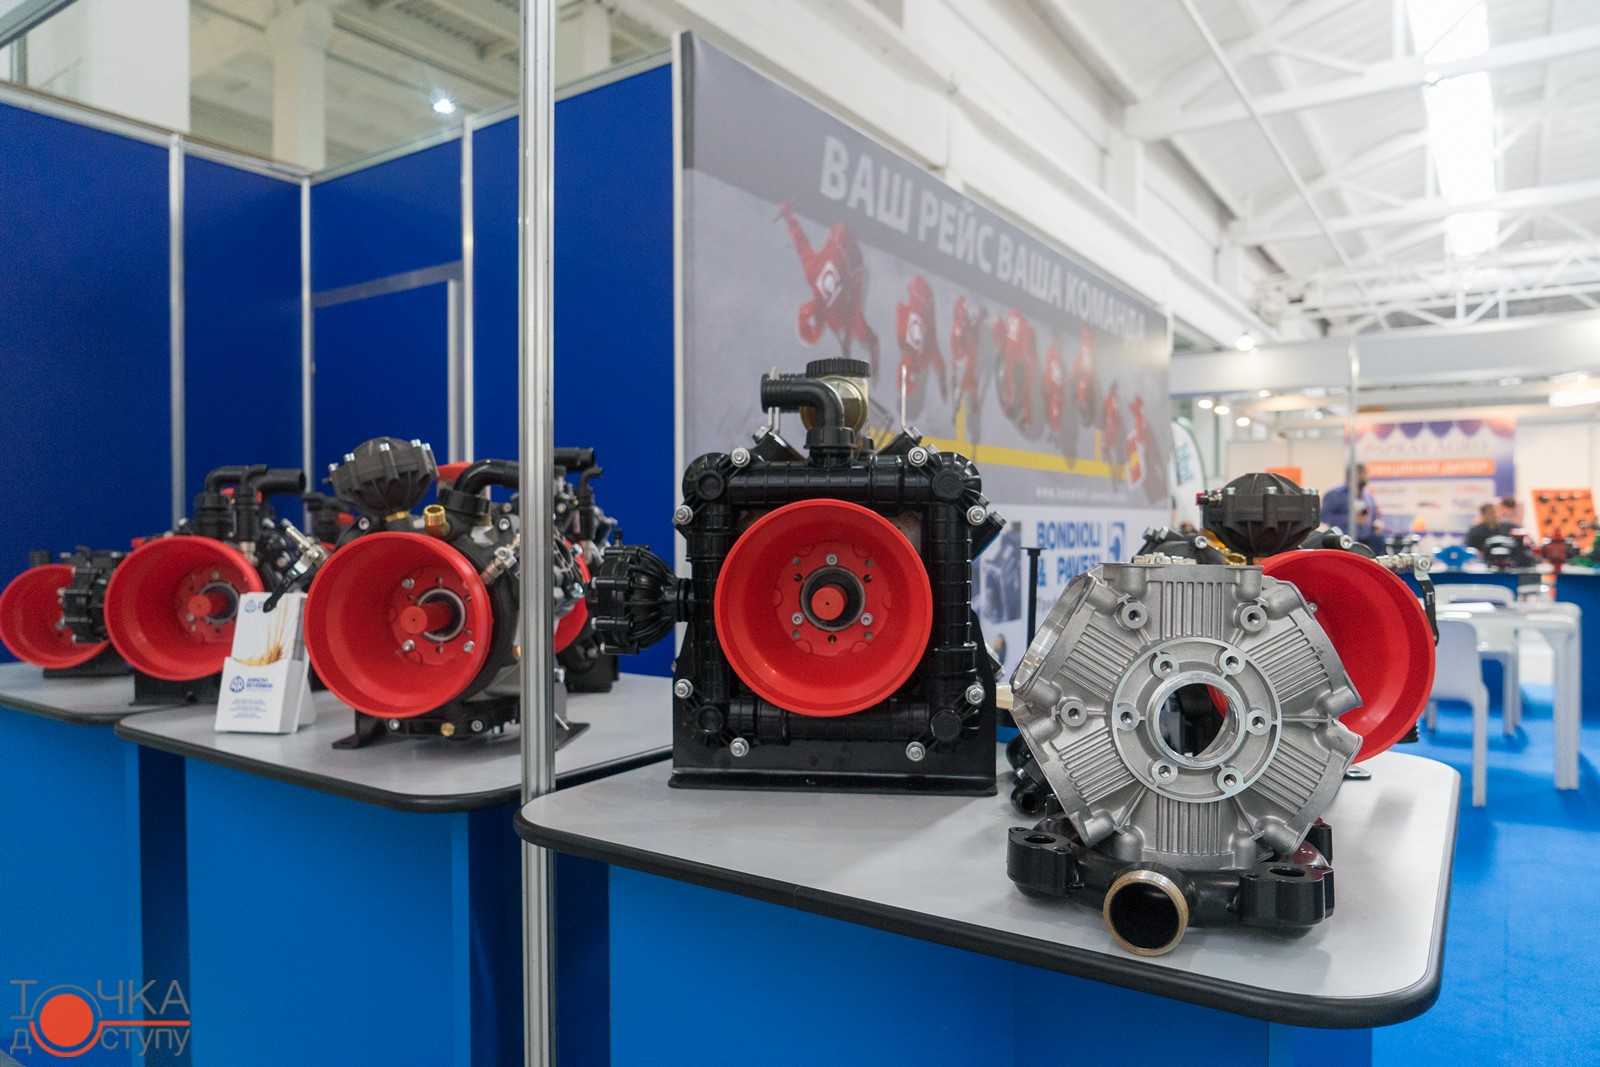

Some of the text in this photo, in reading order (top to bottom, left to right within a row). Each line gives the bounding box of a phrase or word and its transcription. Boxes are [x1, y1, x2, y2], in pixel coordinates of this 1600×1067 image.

[819, 136, 914, 234] ВАШ
[918, 190, 994, 271] РЕЙС
[997, 235, 1063, 307] ВАША
[1036, 521, 1102, 549] BONDIOLI
